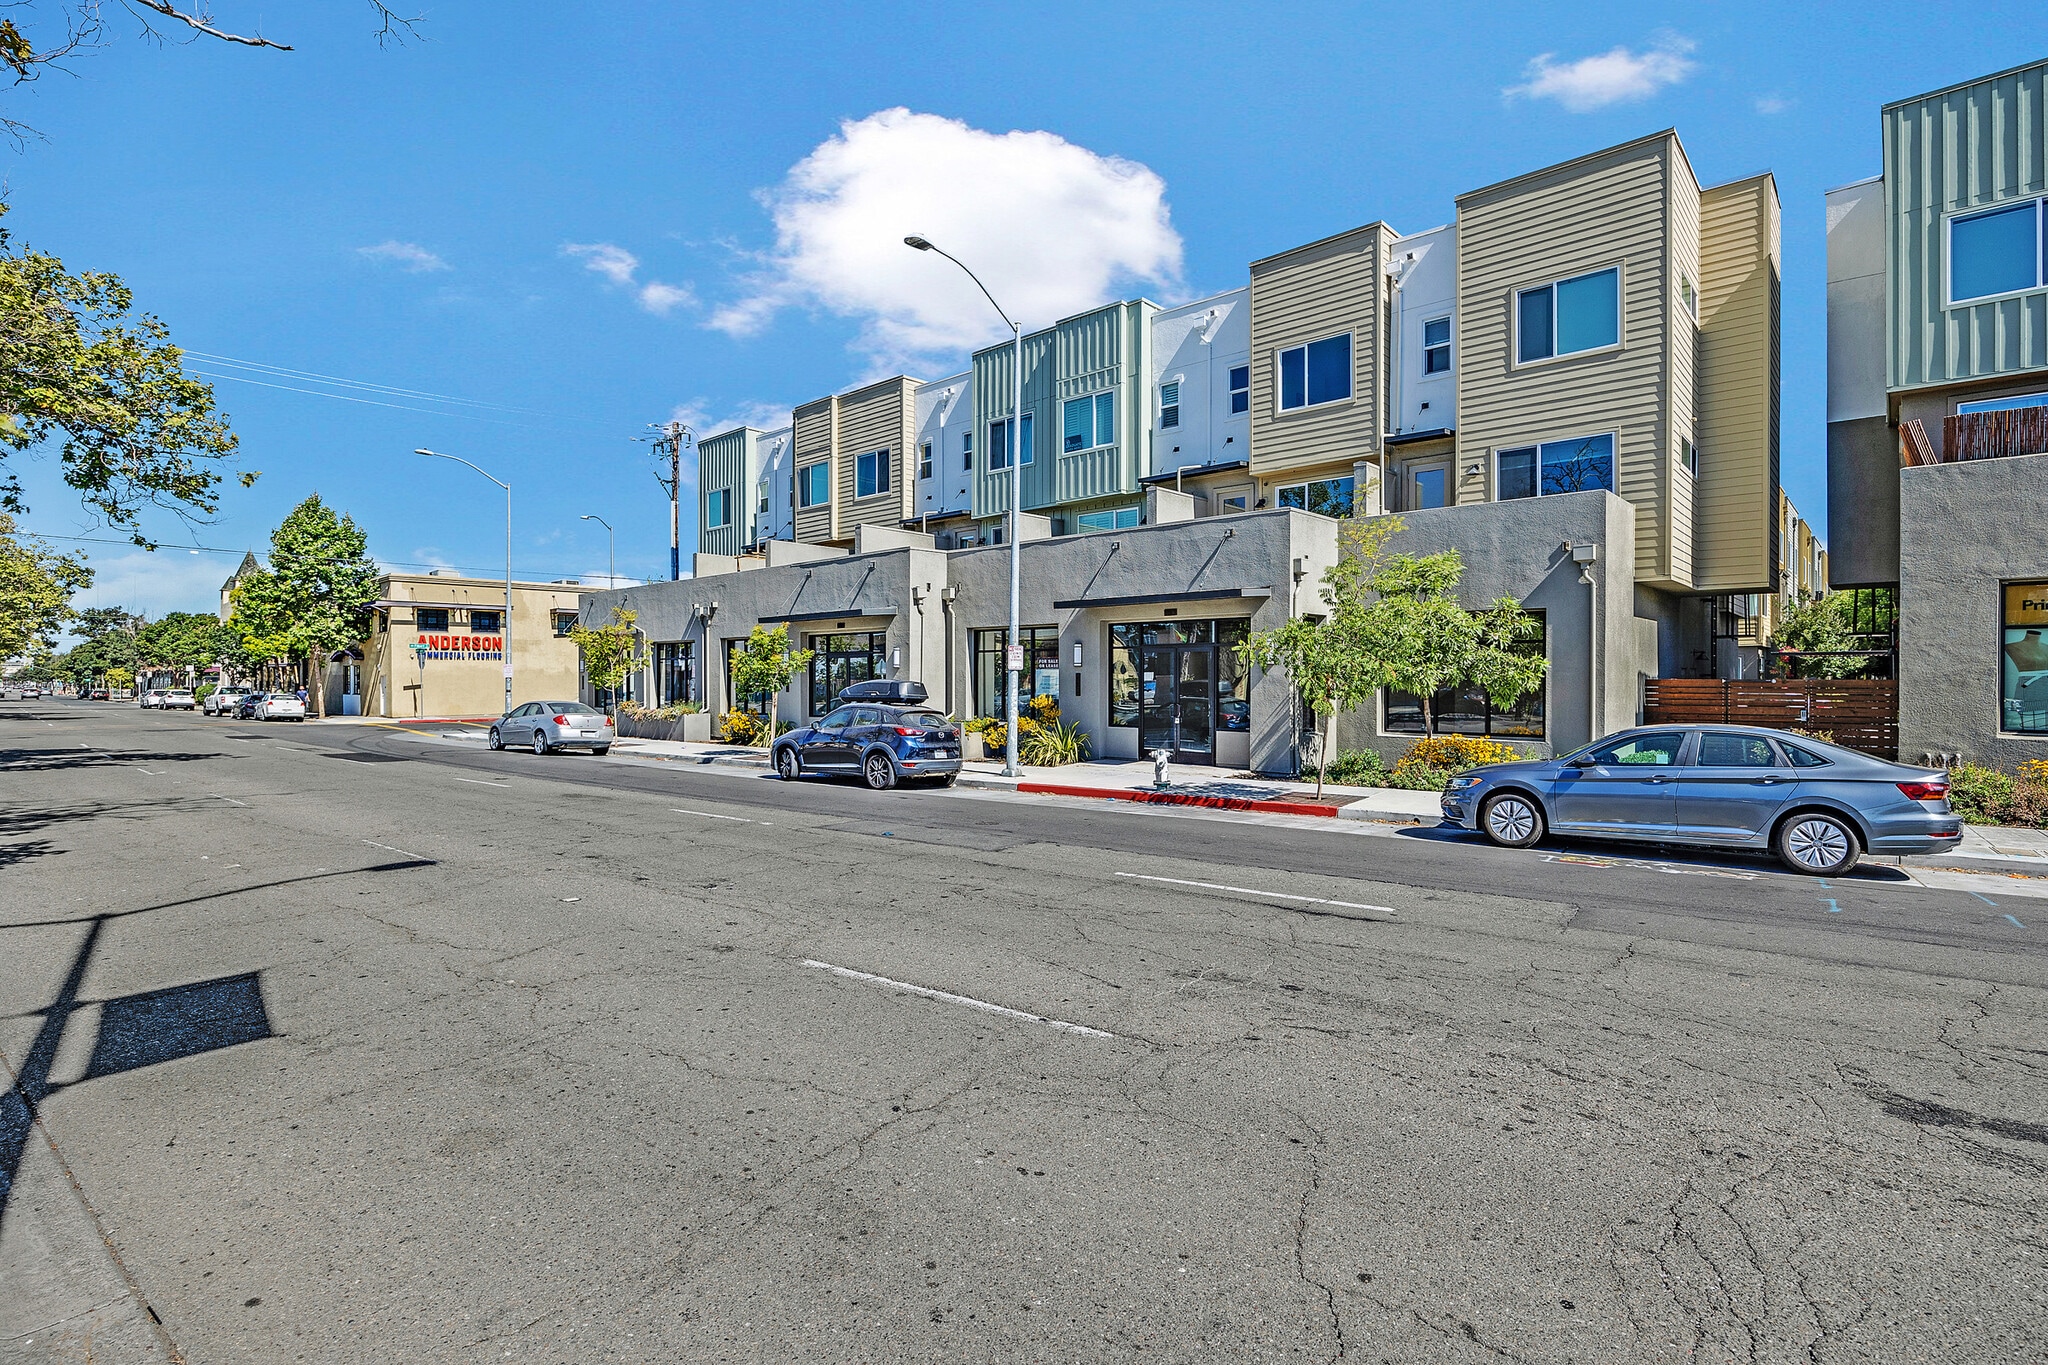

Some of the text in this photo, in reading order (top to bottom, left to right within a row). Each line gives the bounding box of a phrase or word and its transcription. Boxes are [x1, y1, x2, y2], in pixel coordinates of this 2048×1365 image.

[2022, 599, 2048, 611] Pri
[418, 635, 503, 651] ANDERSON
[417, 652, 503, 661] MMERCIAL FLOORING
